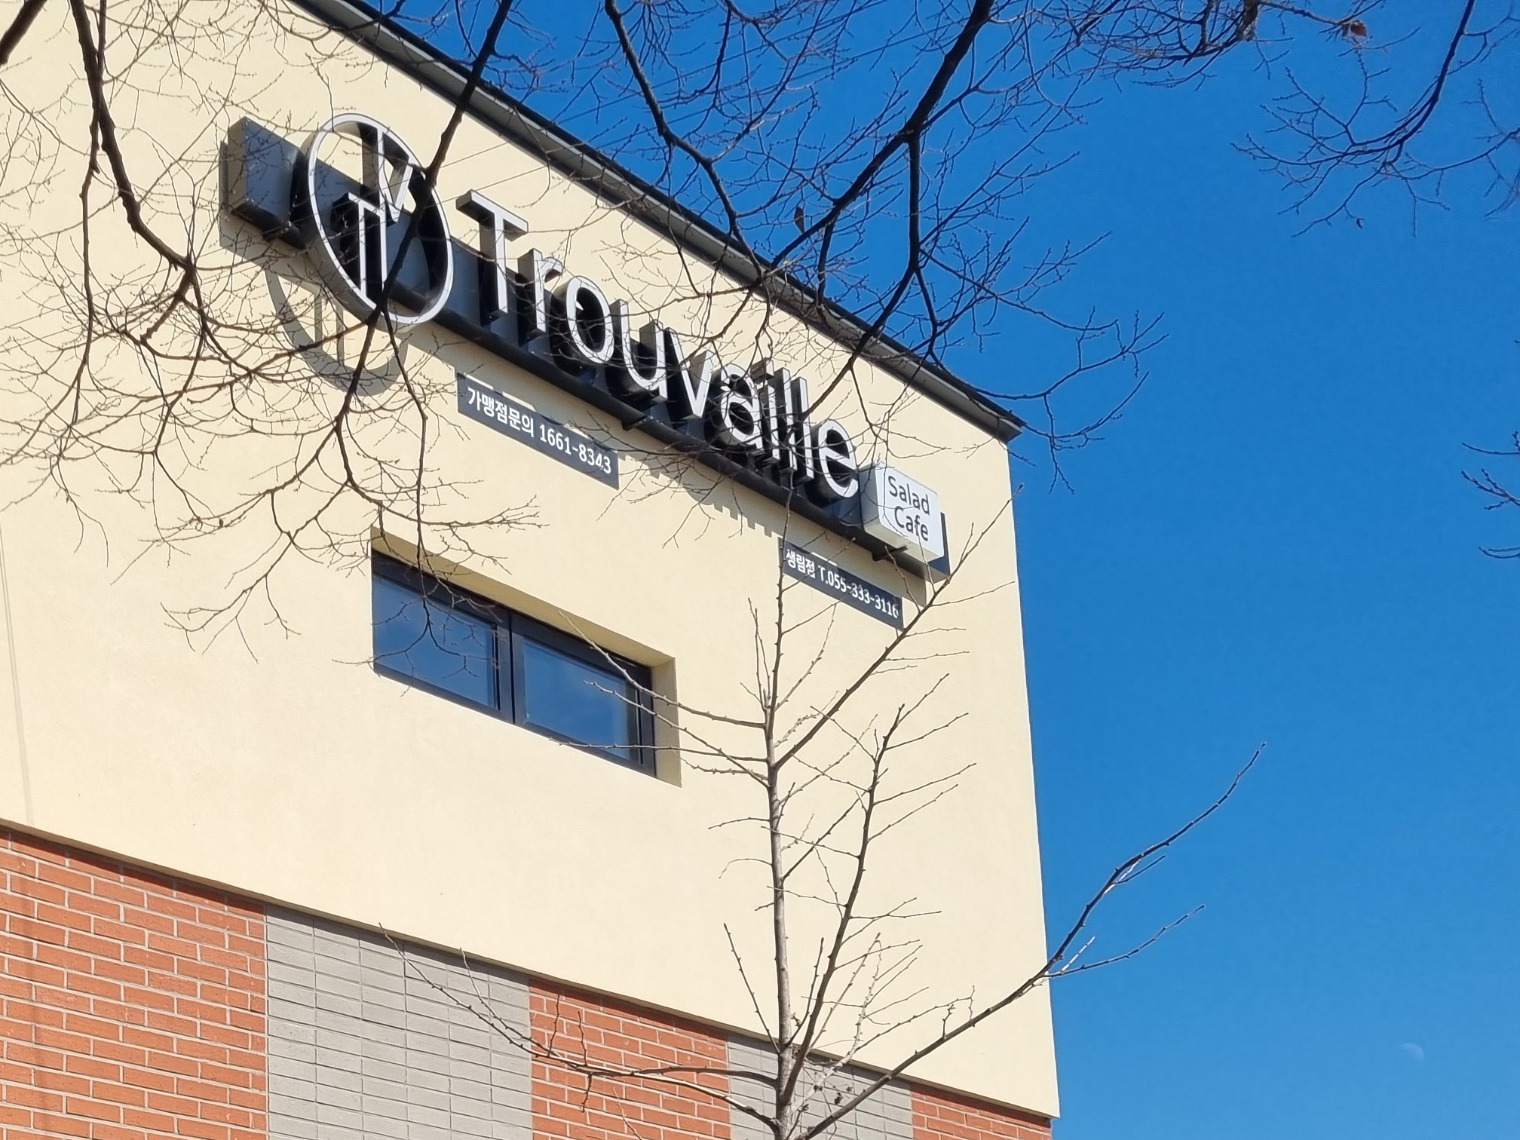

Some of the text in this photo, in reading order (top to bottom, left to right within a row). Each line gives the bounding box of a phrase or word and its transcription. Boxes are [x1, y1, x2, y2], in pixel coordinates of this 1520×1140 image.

[469, 189, 859, 498] Trouvaille
[466, 386, 612, 475] 가맹점문의 1661-8343
[887, 474, 930, 516] Salad
[893, 505, 929, 542] Cafe
